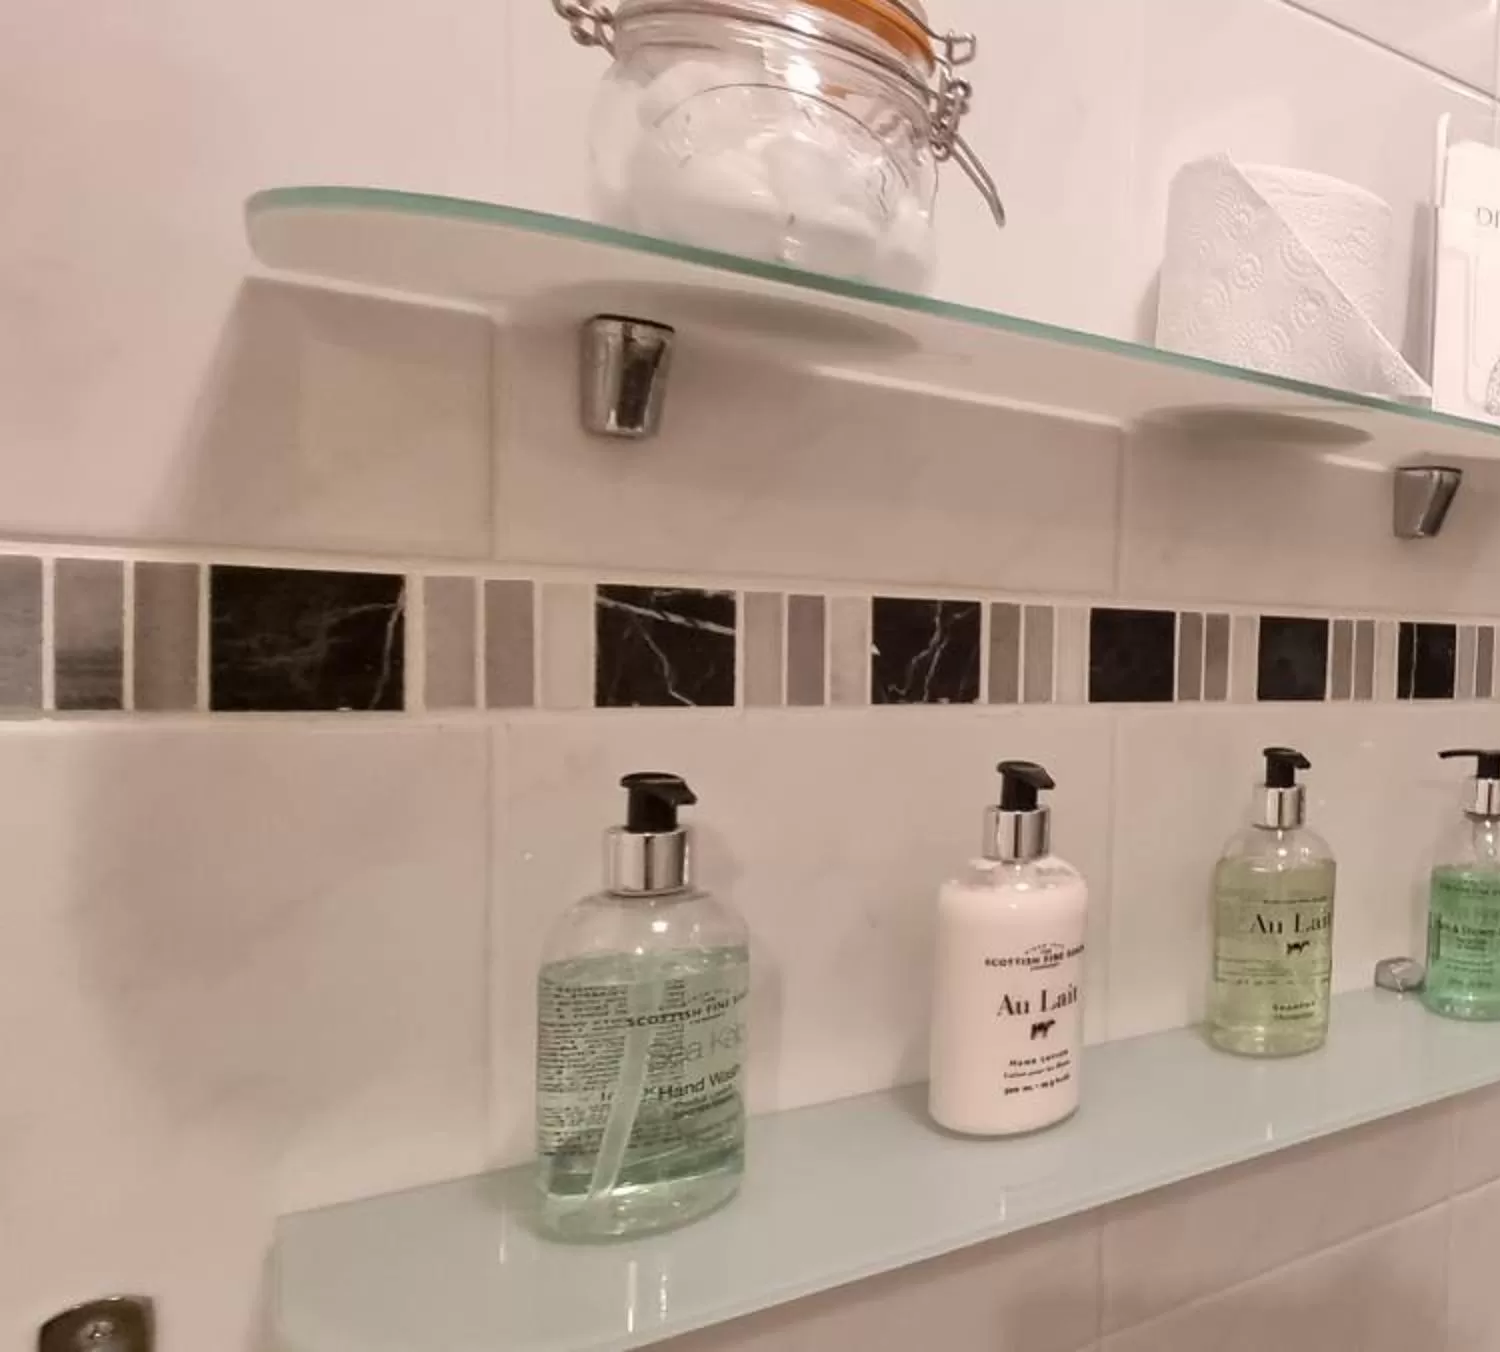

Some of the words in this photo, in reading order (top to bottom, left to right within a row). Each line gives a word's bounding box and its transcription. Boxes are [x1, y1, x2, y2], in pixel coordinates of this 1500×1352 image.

[1250, 913, 1283, 935] Au
[996, 993, 1030, 1016] Au
[1040, 982, 1077, 1013] Lait
[657, 1077, 705, 1101] Hand
